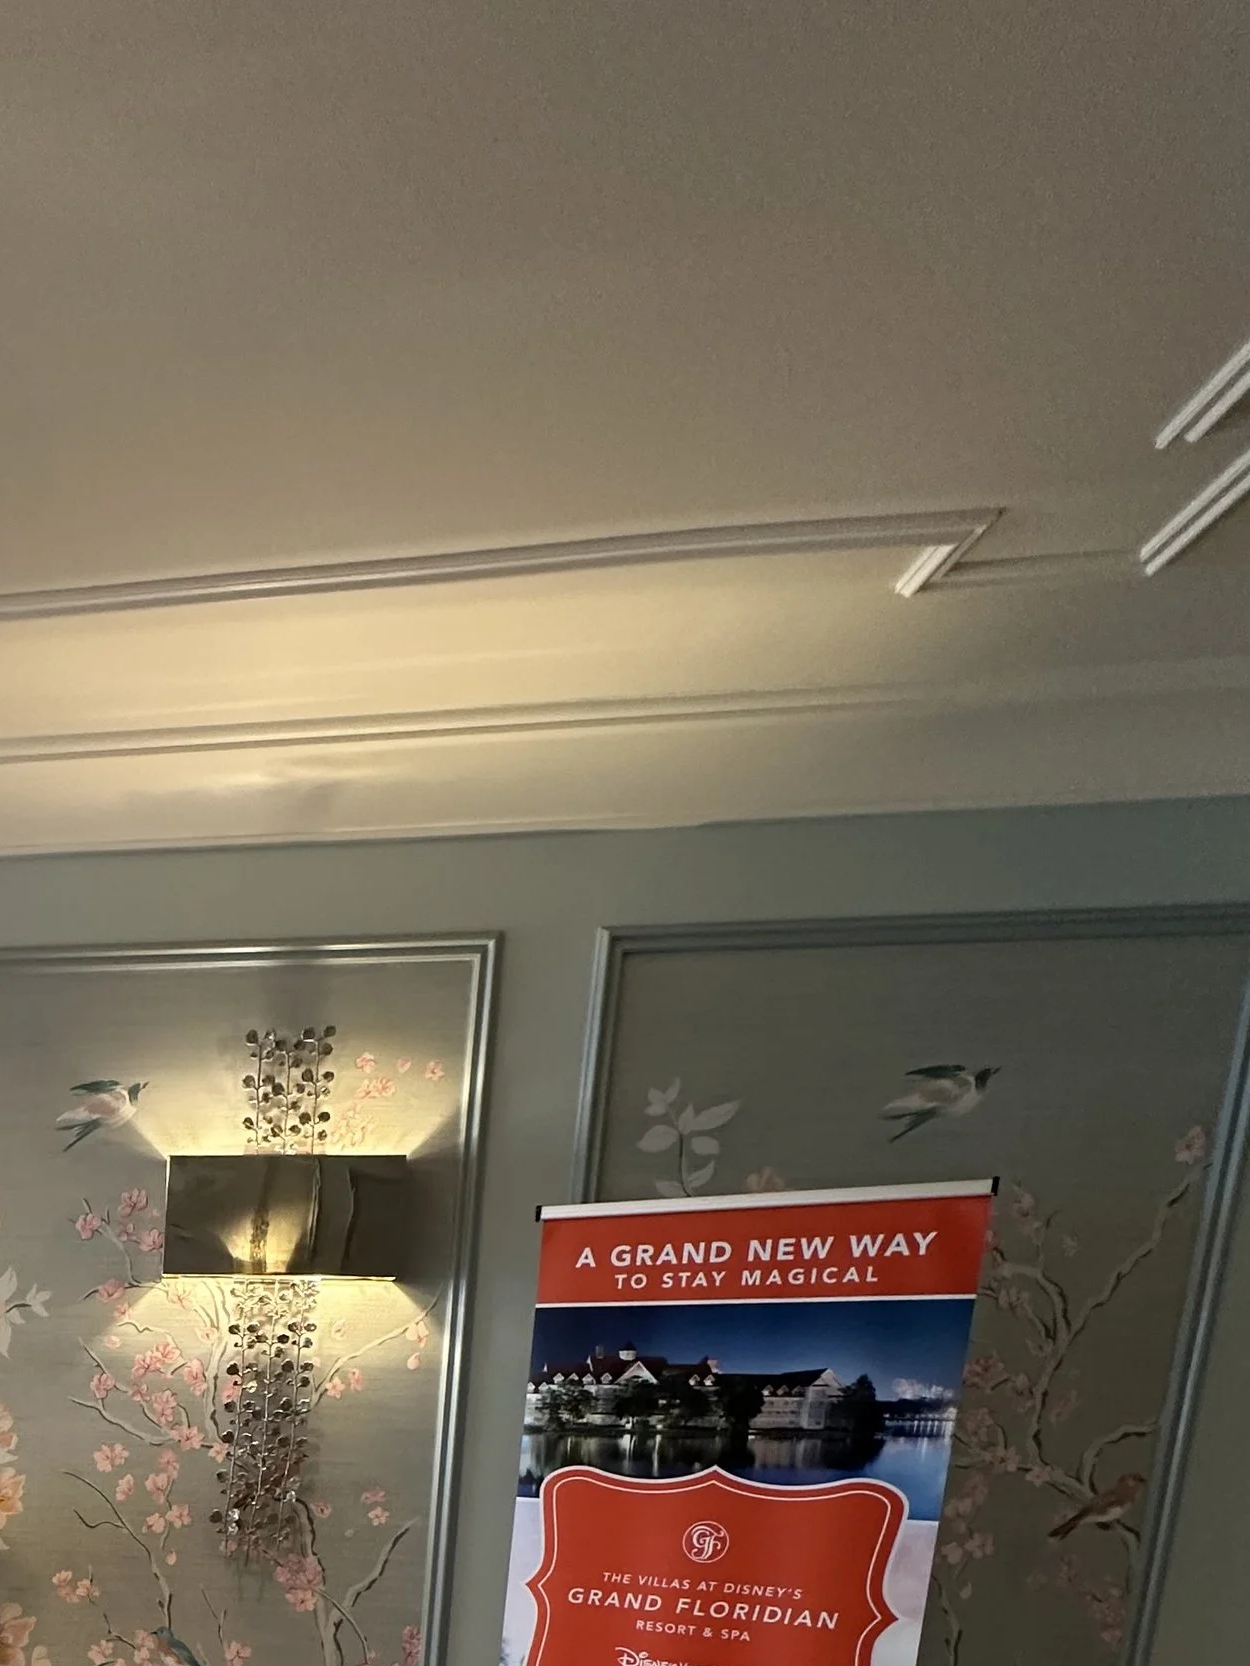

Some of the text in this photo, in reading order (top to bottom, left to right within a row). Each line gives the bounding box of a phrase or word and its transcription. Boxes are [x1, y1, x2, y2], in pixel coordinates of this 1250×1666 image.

[575, 1231, 938, 1269] A GRAND NEW WAY
[615, 1265, 879, 1290] TO STAY MAGICAL
[603, 1571, 803, 1600] THE VILLAS AT DISNEY'S
[568, 1587, 839, 1630] GRAND FLORIDIAN
[636, 1619, 750, 1642] RESORT & SPA
